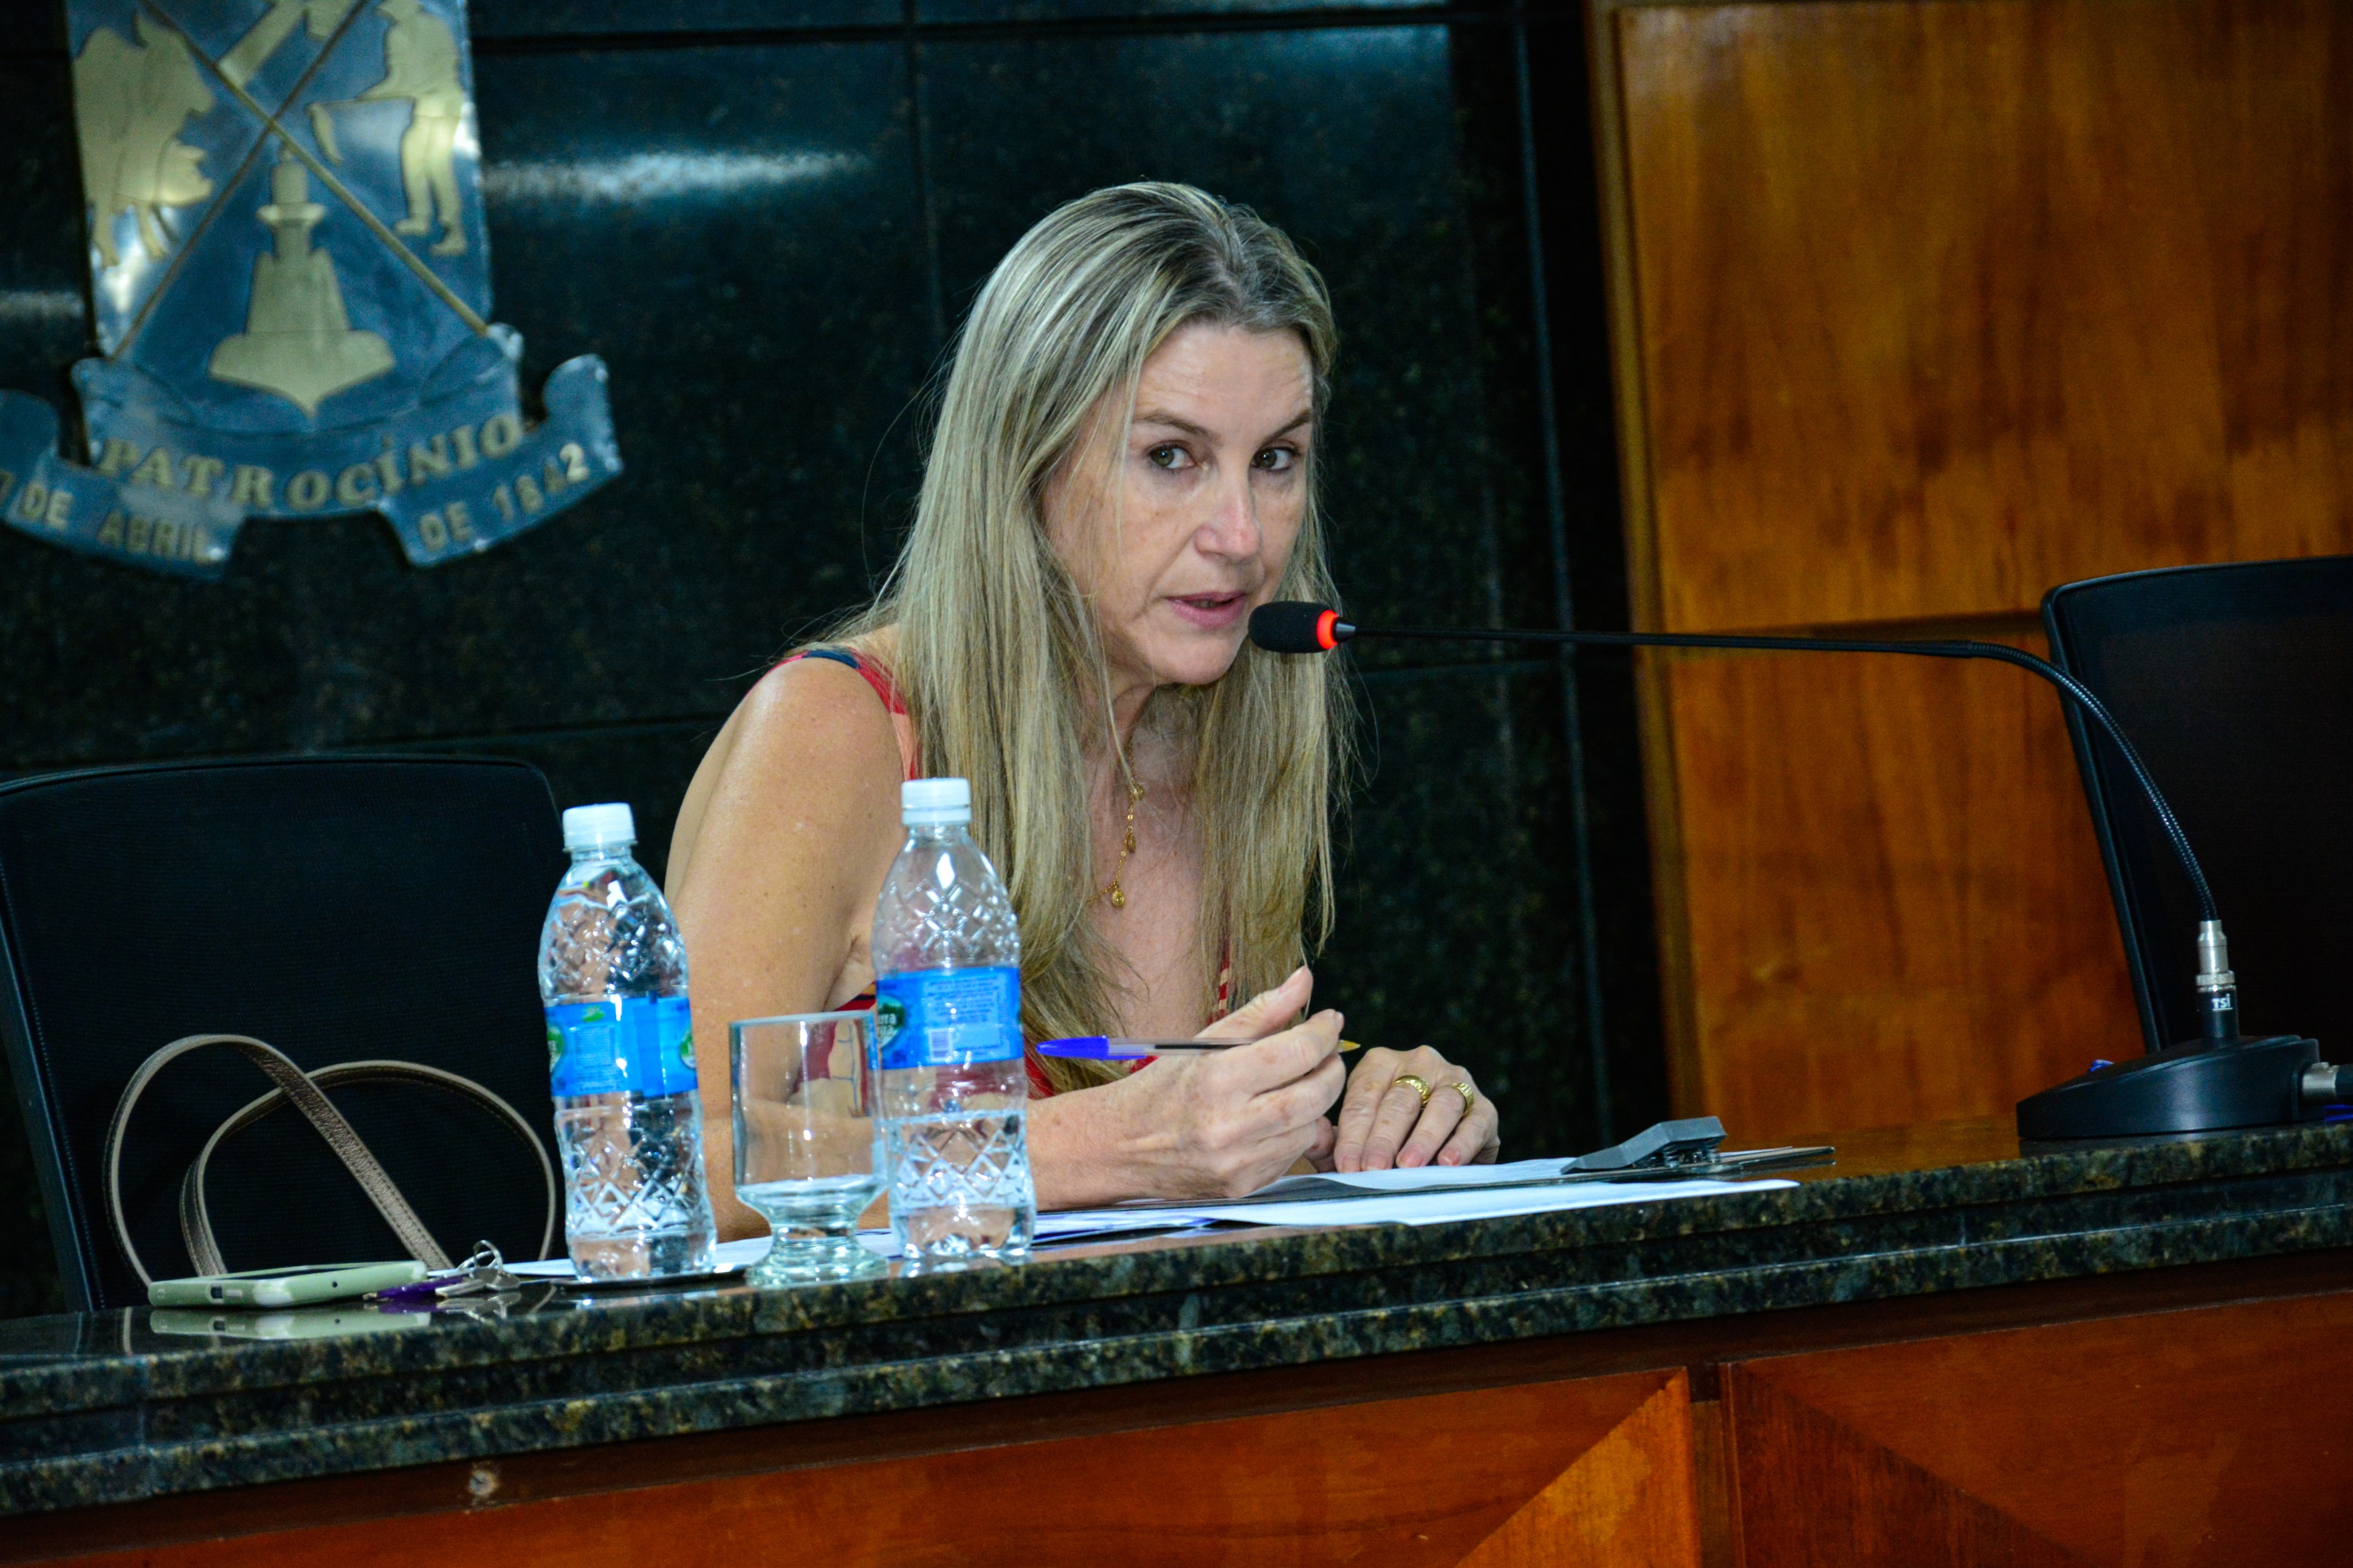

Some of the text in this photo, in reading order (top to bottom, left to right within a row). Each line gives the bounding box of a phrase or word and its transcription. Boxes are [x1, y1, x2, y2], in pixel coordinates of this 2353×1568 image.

[97, 416, 524, 510] PATROCÍNIO
[22, 484, 74, 530] DE
[97, 510, 216, 565] ABRIL
[419, 501, 473, 550] DE
